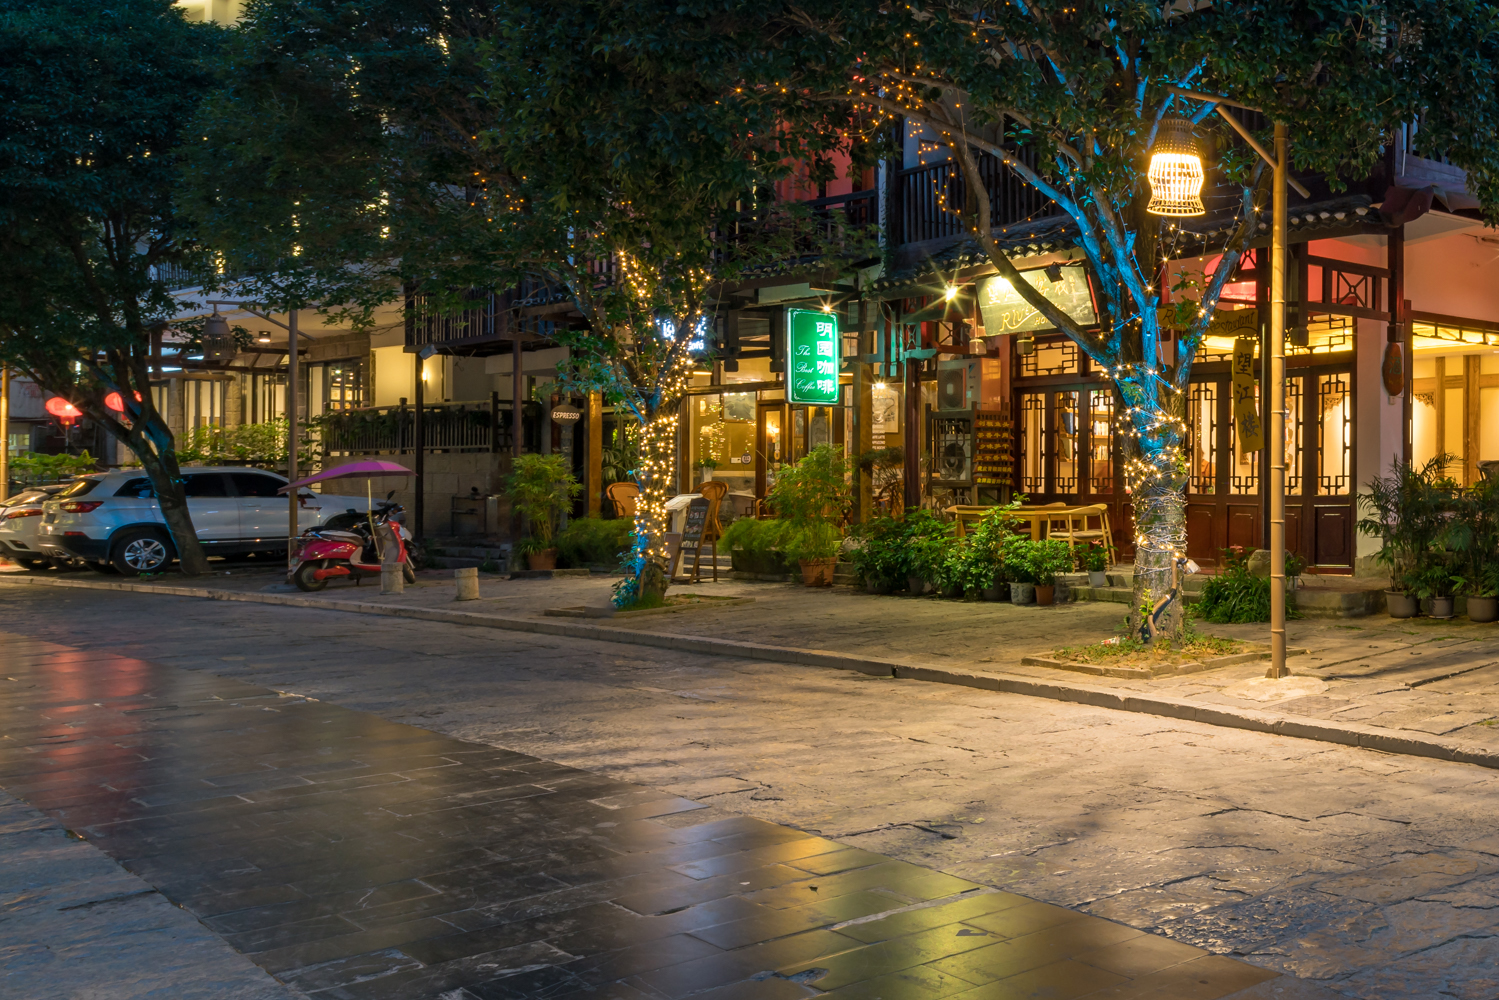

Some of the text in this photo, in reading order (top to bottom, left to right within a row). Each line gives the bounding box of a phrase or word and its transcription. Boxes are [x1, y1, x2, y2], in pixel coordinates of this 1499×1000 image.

[795, 344, 811, 356] The
[815, 321, 835, 395] 明园咖啡
[795, 361, 815, 373] Best
[795, 378, 816, 393] Coffee
[1235, 351, 1260, 439] 望江楼
[552, 411, 580, 420] ESPRESSO
